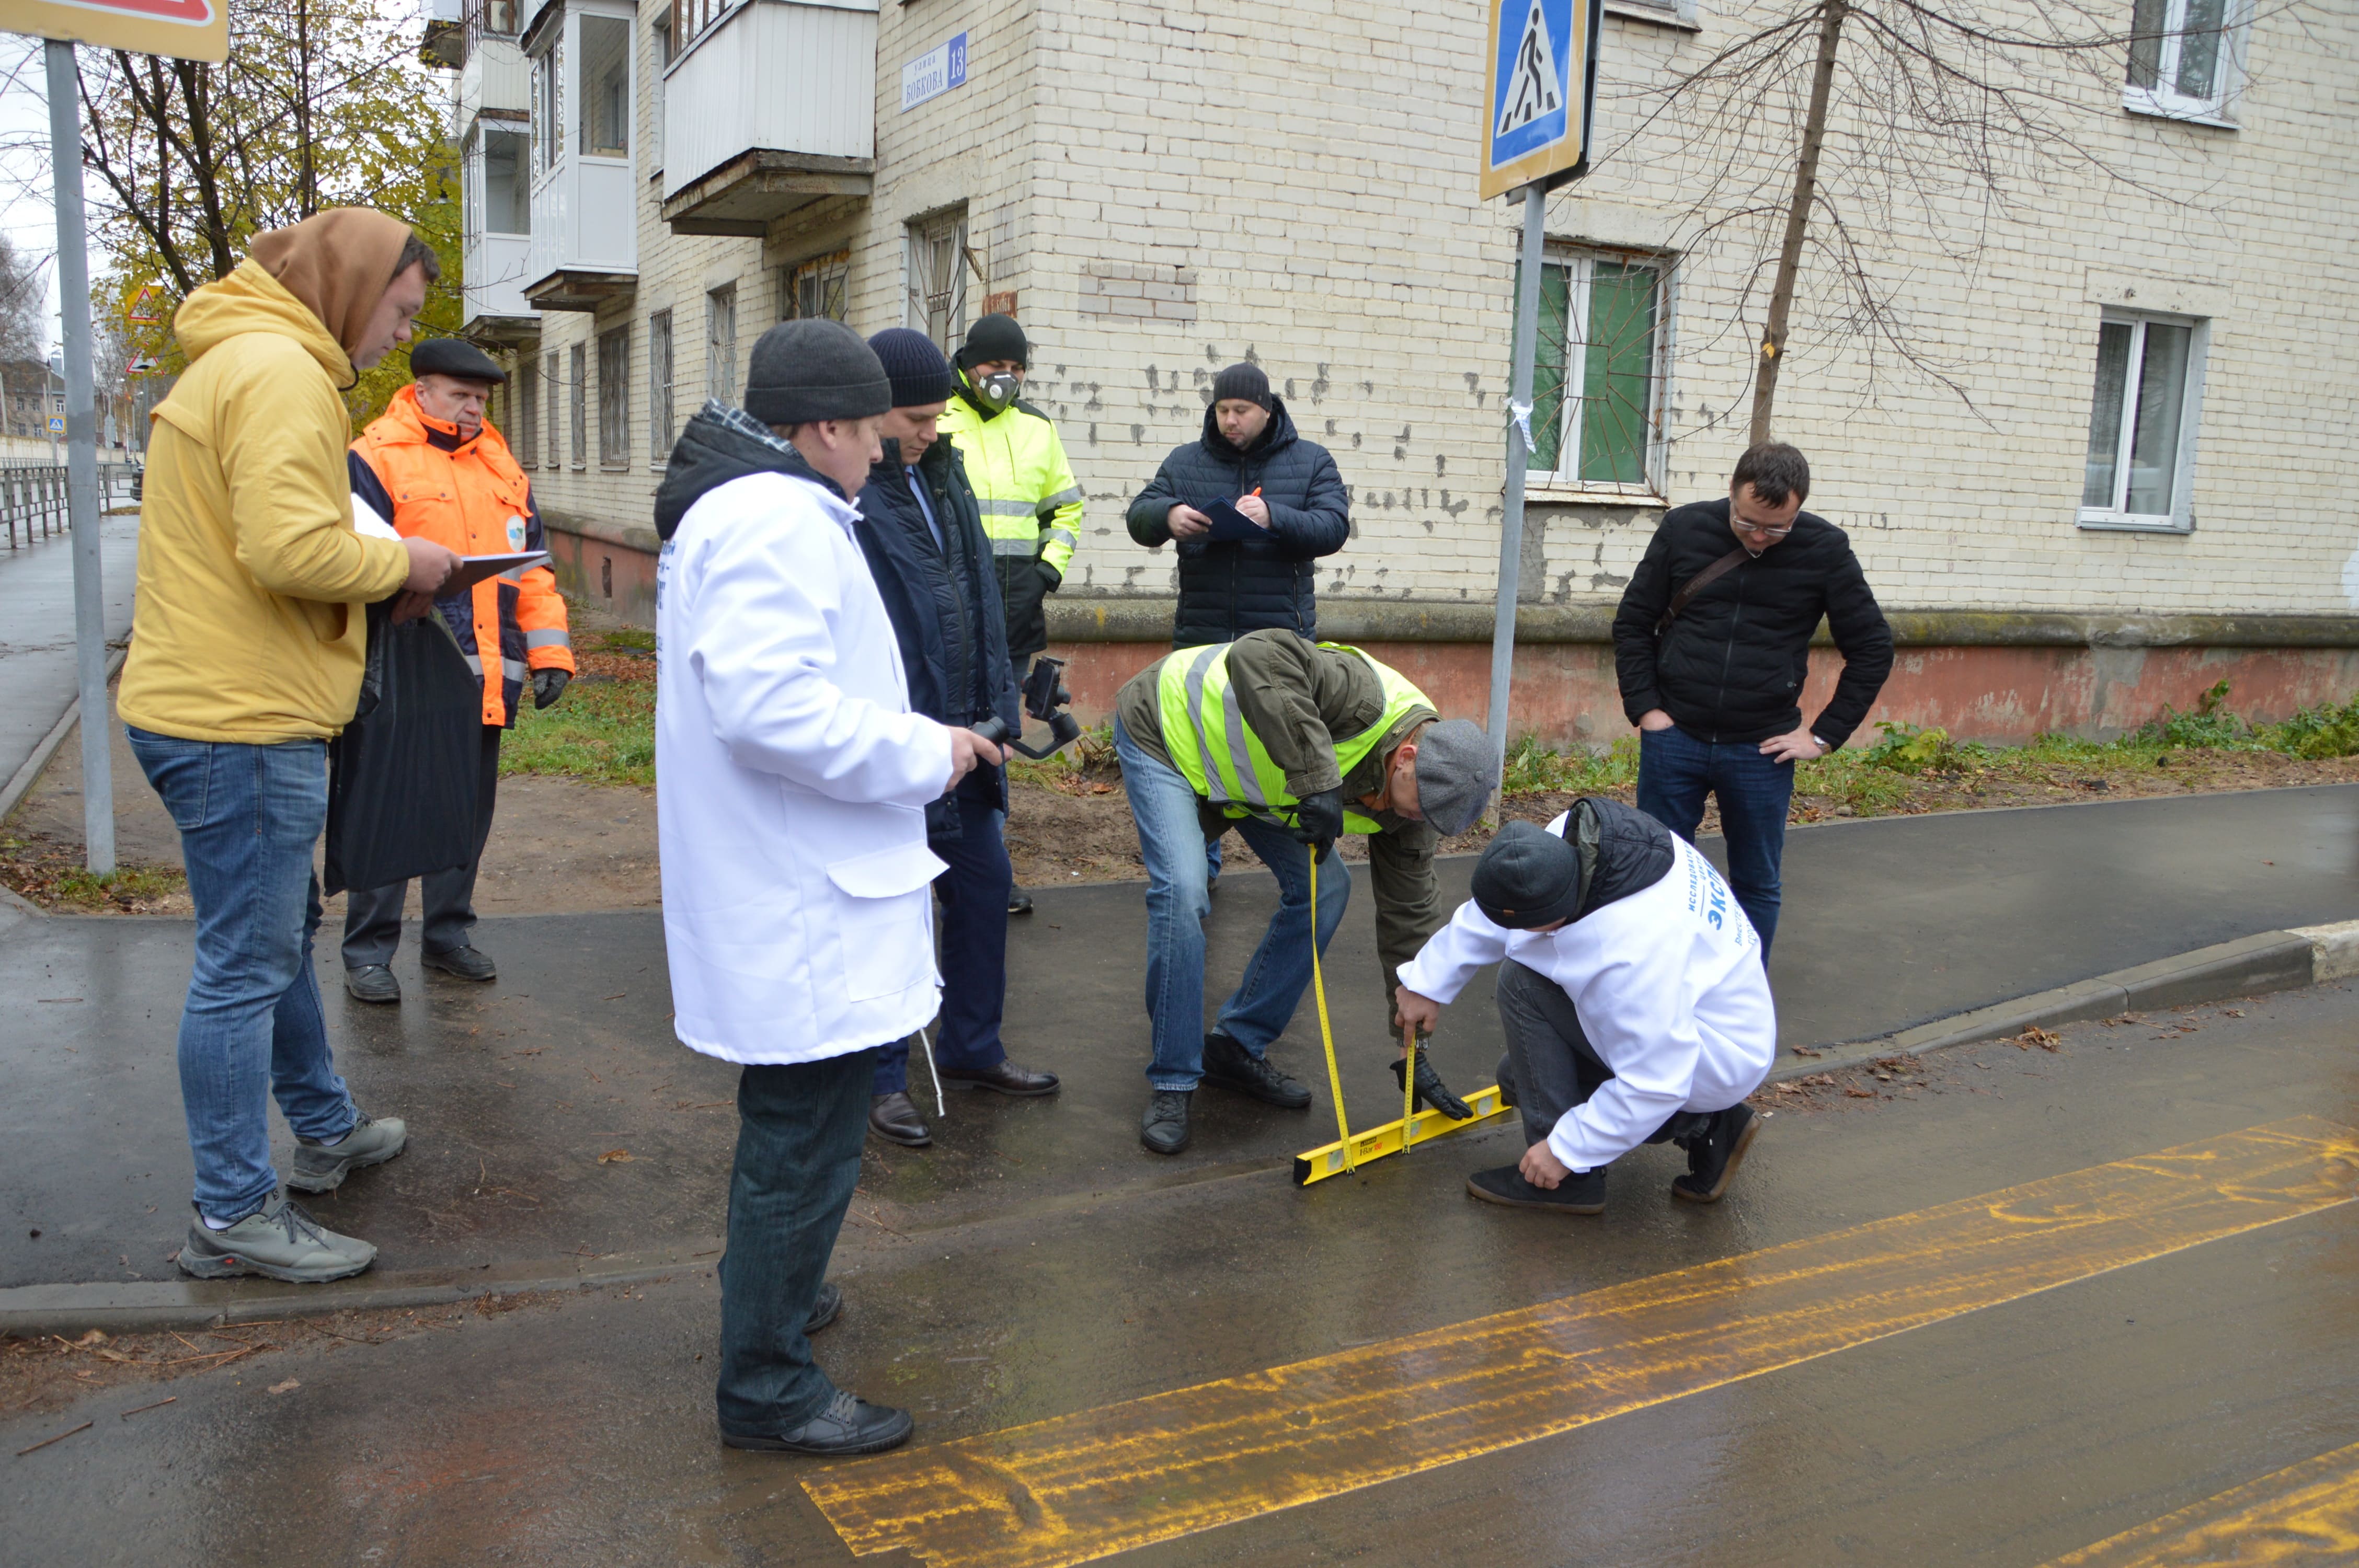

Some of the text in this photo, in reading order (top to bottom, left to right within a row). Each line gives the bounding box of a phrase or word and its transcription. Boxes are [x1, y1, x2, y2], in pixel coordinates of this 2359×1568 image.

[914, 55, 936, 76] улица
[951, 45, 964, 79] 13
[906, 67, 943, 103] БОБКОВА
